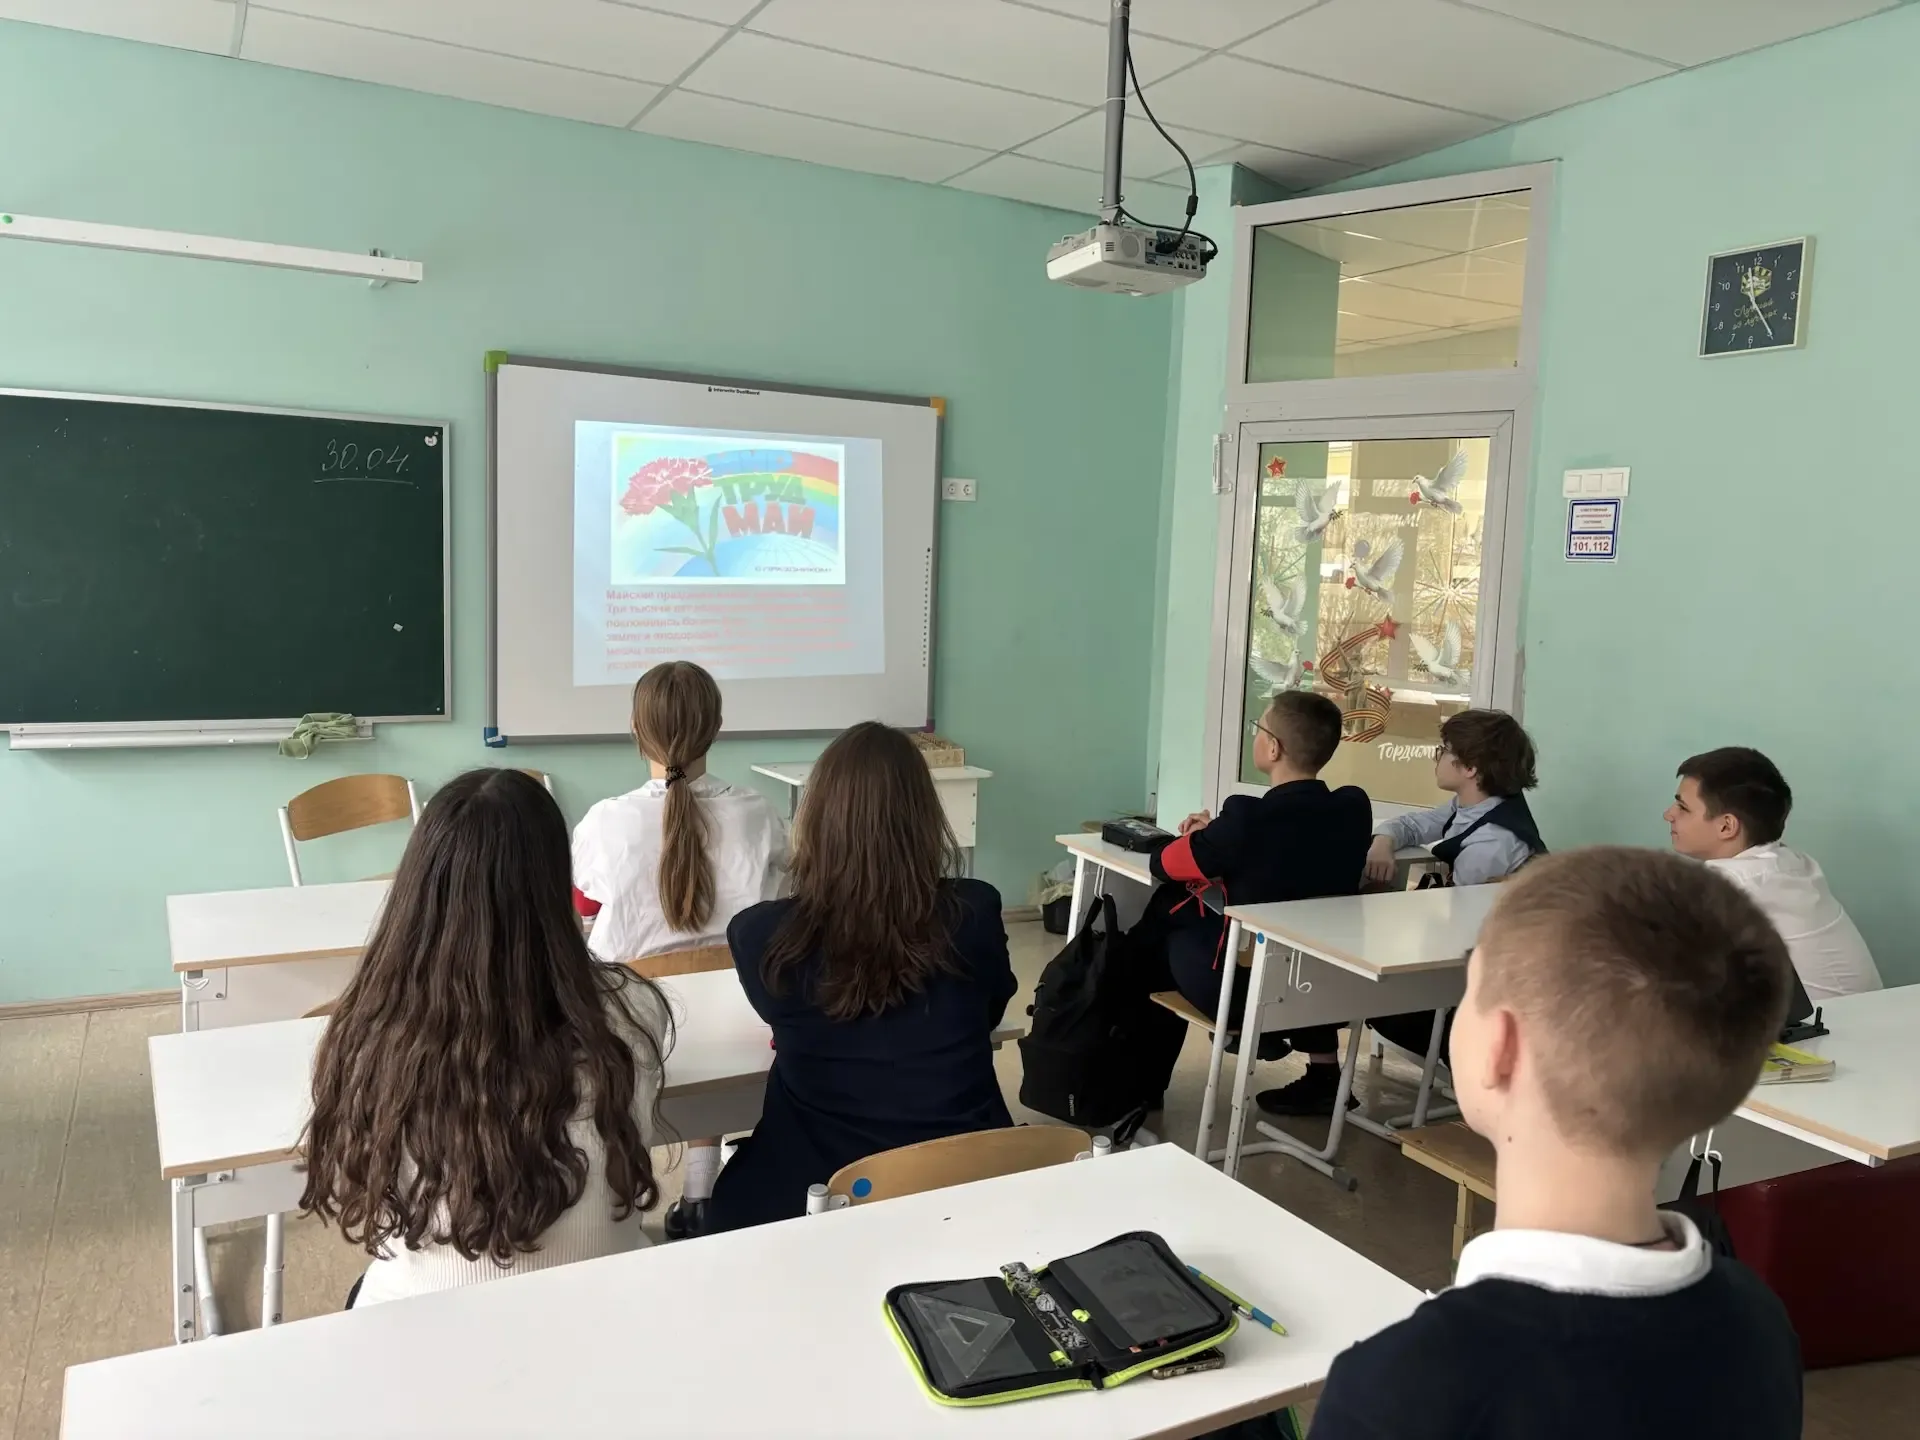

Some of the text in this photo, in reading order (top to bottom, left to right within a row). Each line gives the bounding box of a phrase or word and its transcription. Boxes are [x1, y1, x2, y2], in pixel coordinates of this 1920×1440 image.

[1753, 257, 1763, 265] 12
[1736, 265, 1745, 273] 11
[1786, 272, 1793, 281] 2
[1721, 282, 1731, 291] 10
[1790, 291, 1796, 300] 3
[1715, 302, 1720, 311] 9
[1782, 312, 1788, 320] 4
[1718, 321, 1724, 330] 8
[1730, 333, 1735, 342] 7
[1748, 336, 1754, 344] 6
[720, 473, 807, 505] ТРУД
[1573, 541, 1609, 552] 101, 112
